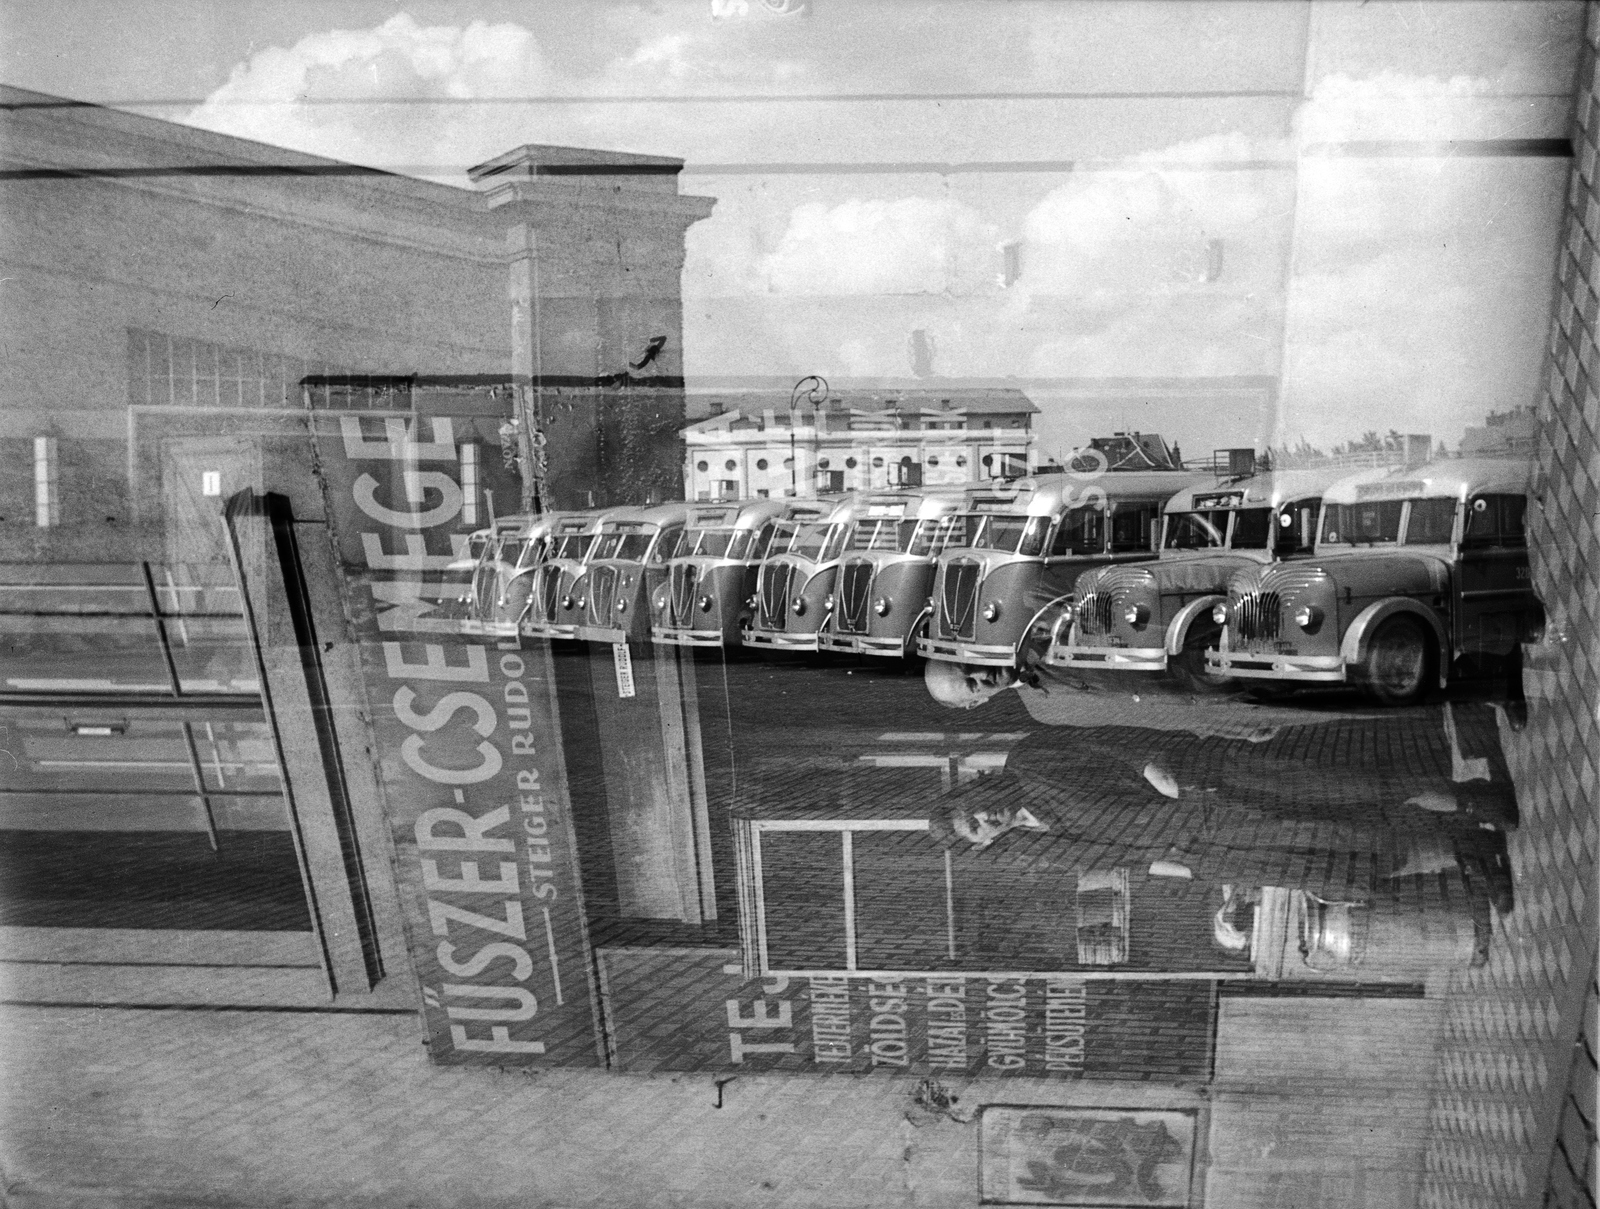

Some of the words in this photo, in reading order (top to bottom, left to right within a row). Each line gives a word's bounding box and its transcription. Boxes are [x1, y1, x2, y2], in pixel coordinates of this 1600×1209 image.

[339, 416, 546, 1055] FŰSZER-CSEMEGE
[515, 767, 558, 900] STEIGER
[722, 964, 795, 1064] TEJ
[927, 1020, 967, 1069] HAZAI
